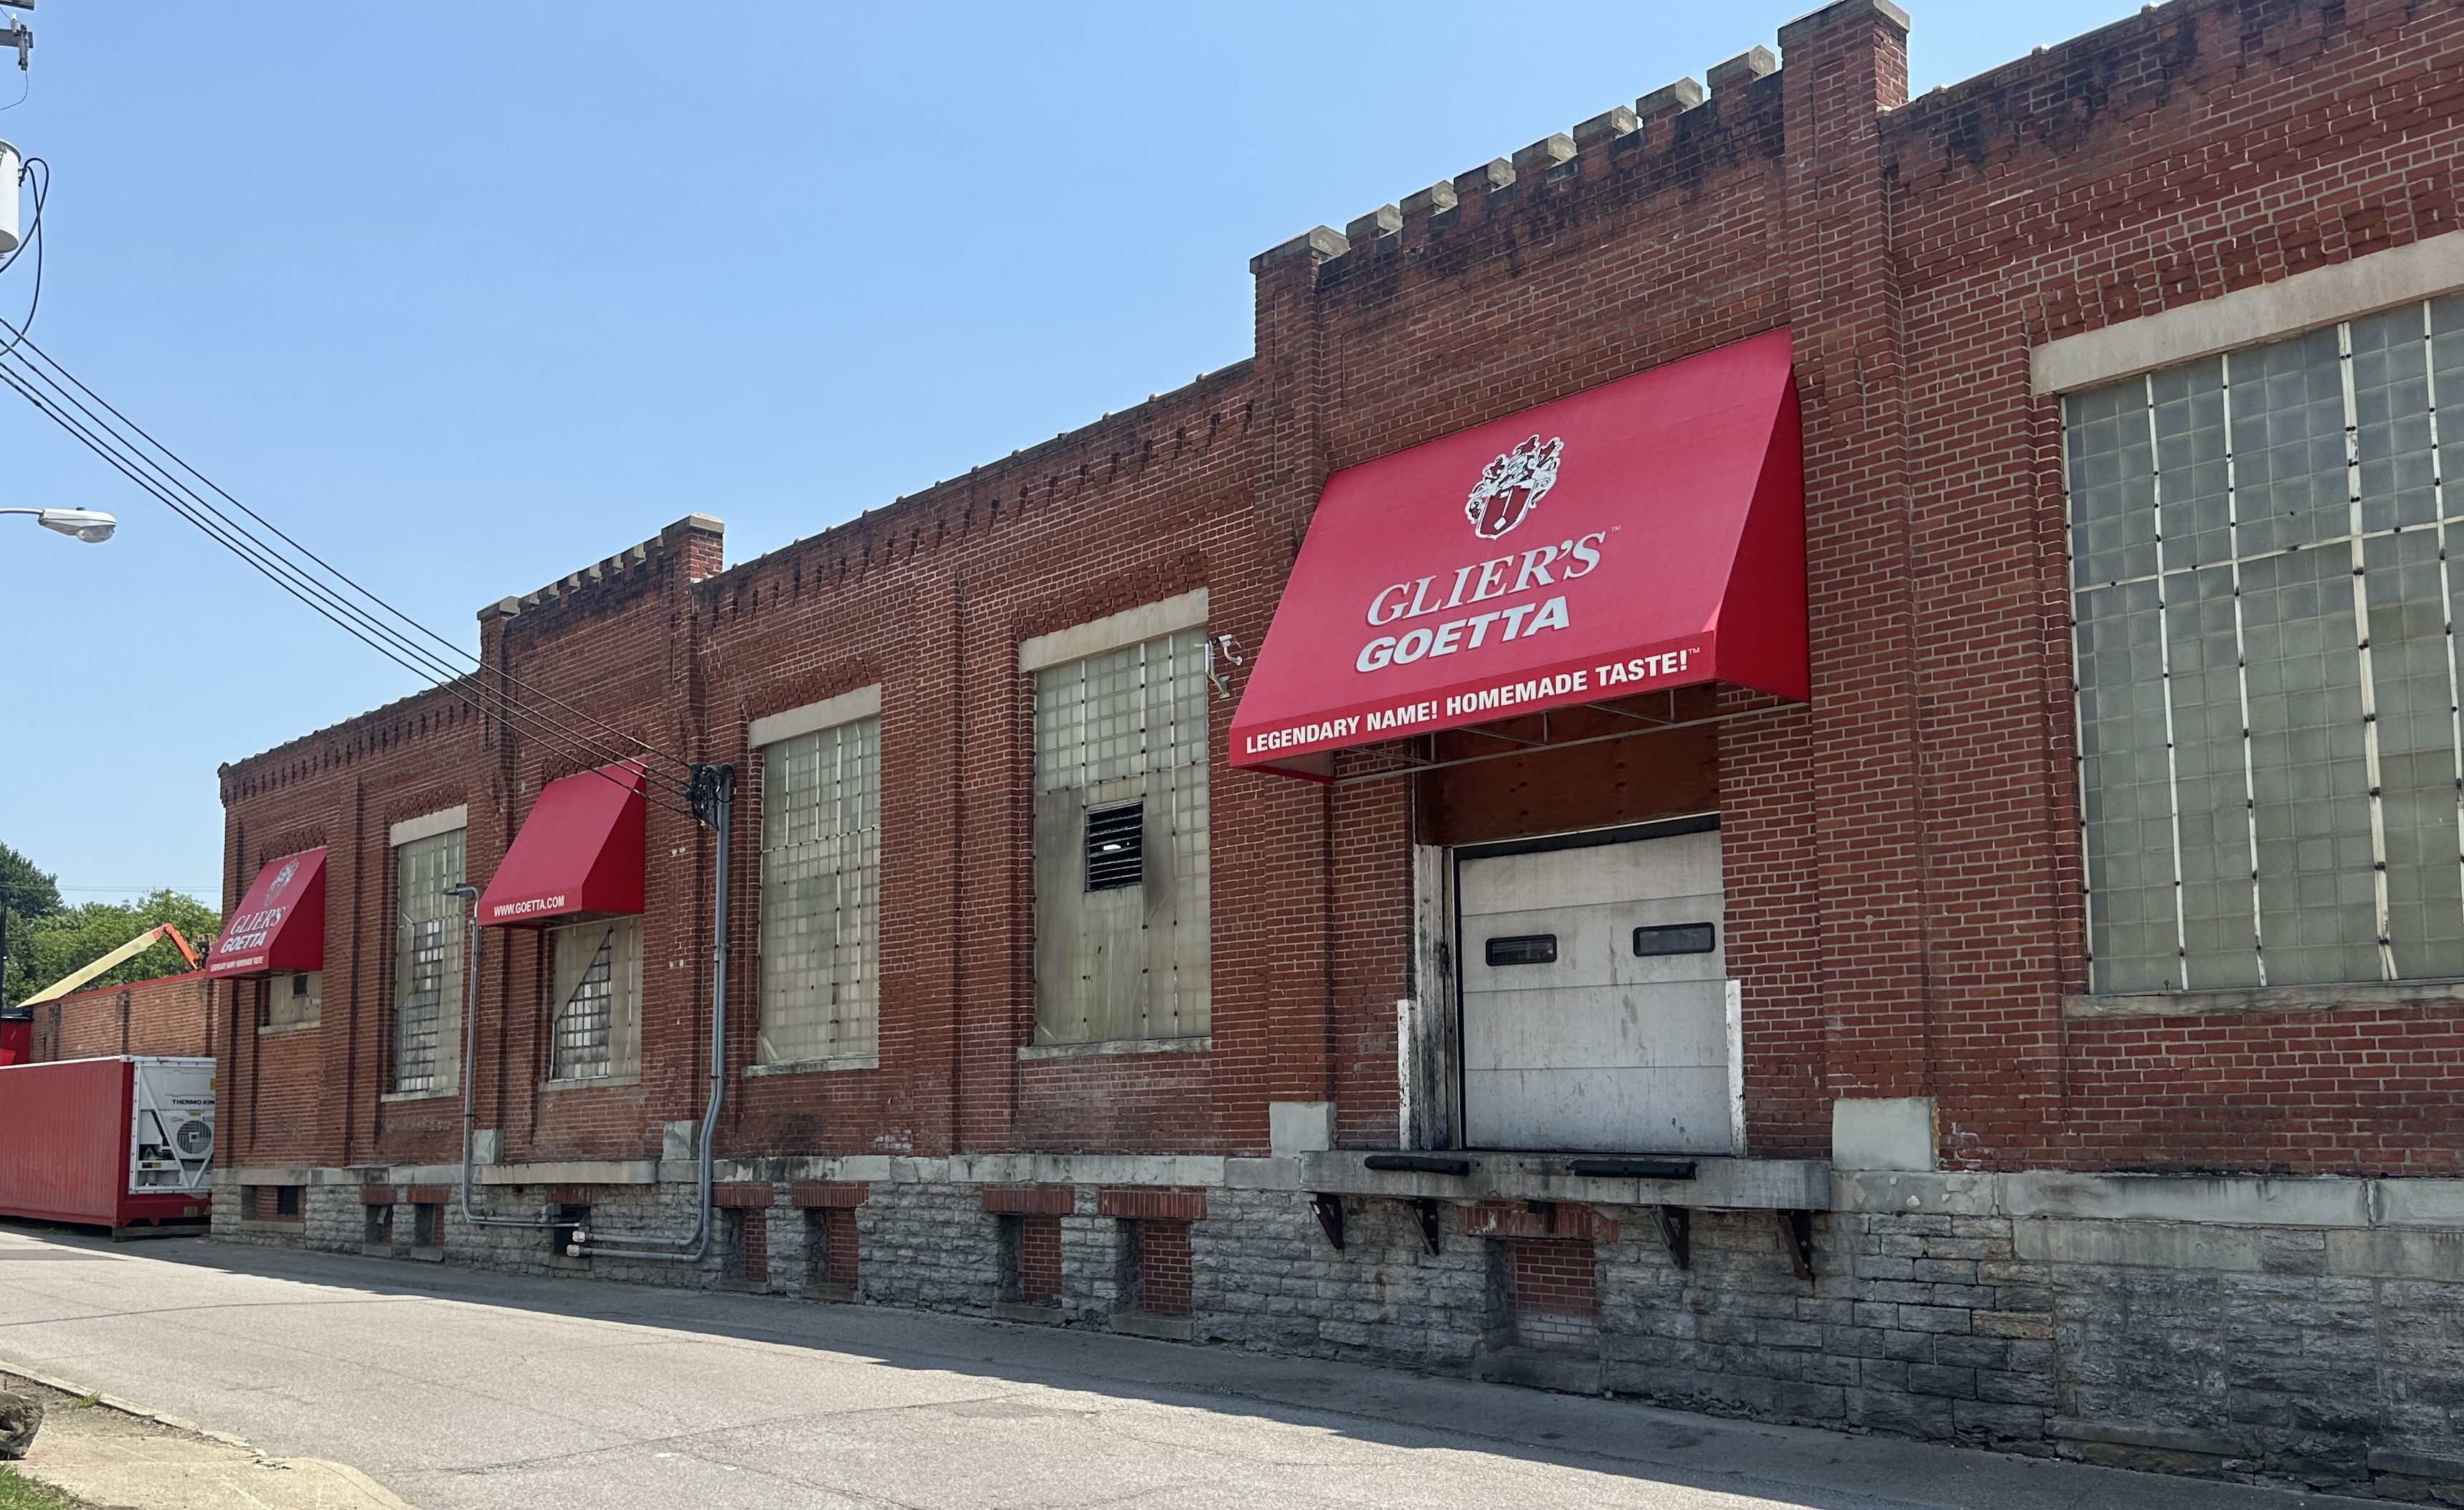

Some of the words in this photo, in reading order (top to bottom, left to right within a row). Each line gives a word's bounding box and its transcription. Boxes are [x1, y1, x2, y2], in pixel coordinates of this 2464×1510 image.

[1367, 531, 1606, 626] GLIER'S
[1355, 595, 1570, 672] GOETTA
[1246, 715, 1361, 754] LEGENDARY
[1366, 700, 1438, 732] NAME!
[1446, 669, 1588, 717] HOMEMADE
[1594, 649, 1688, 687] TASTE!
[229, 906, 287, 935] GLIER'S
[493, 895, 565, 917] WWW.GOETTA.COM
[219, 930, 267, 954] GOETTA
